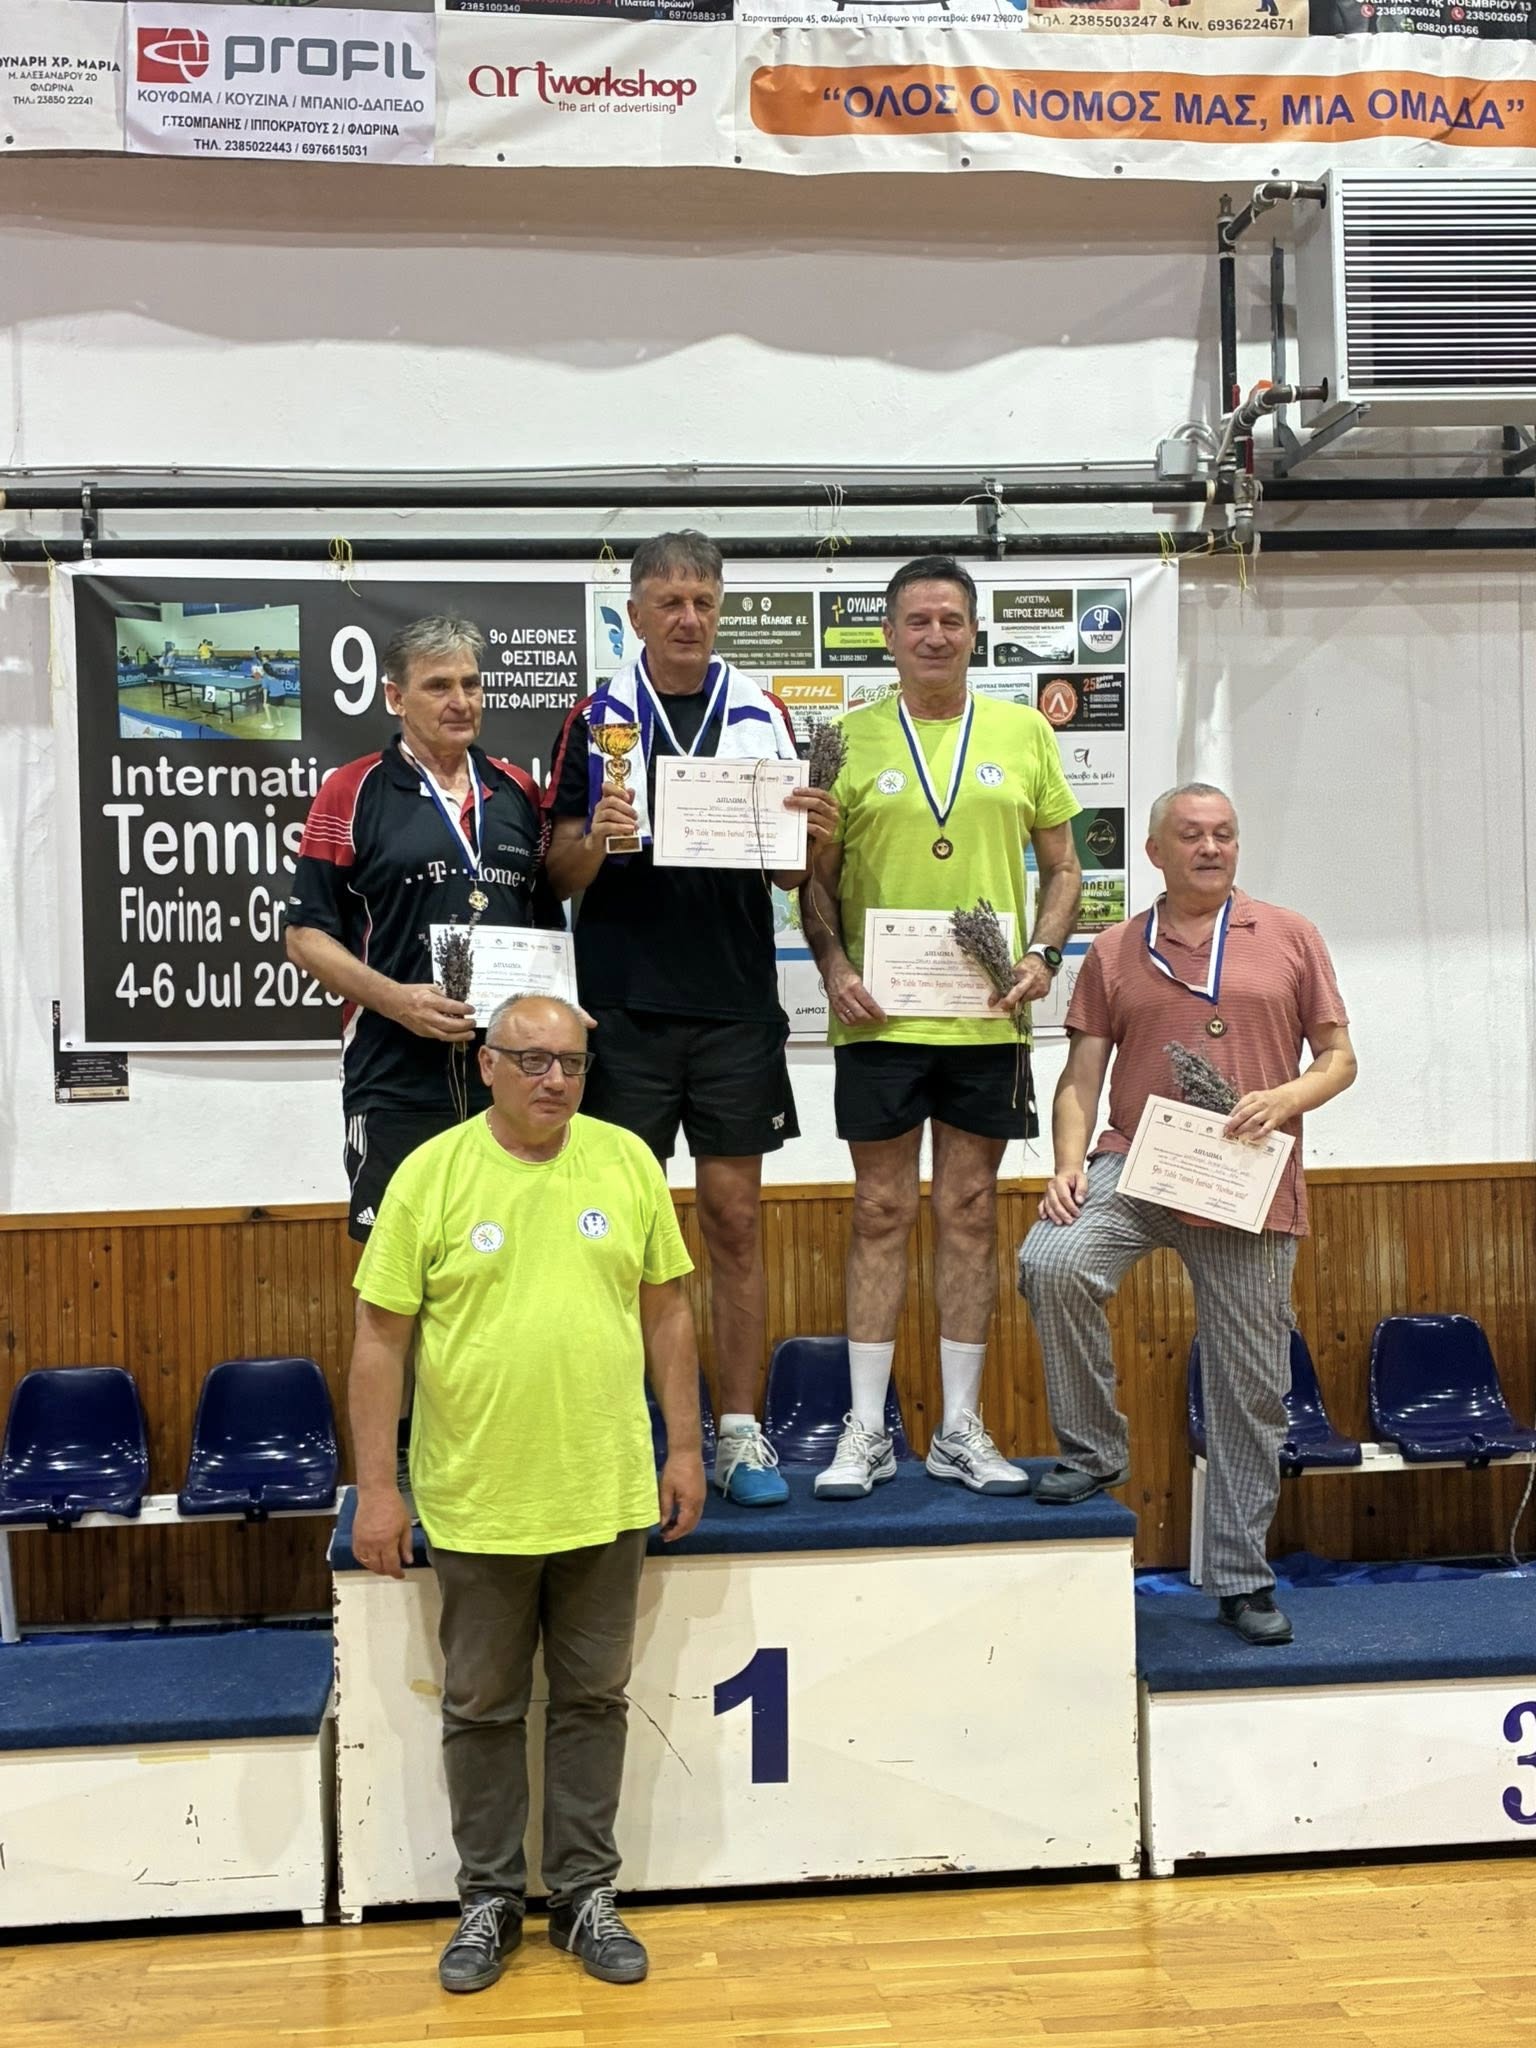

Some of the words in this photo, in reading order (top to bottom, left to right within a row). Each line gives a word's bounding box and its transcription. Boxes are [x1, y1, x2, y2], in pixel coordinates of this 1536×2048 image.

[742, 14, 803, 24] Σαρανταπόρου
[821, 14, 858, 24] Φλώρινα
[867, 14, 909, 24] Τηλέφωνο
[912, 15, 925, 24] για
[971, 14, 991, 23] 6947
[1376, 6, 1441, 18] 2385026024
[1466, 11, 1529, 23] 2385026057
[1033, 14, 1064, 27] Τηλ.
[1069, 15, 1157, 28] 2385503247
[1162, 17, 1173, 27] &
[1178, 17, 1202, 31] Κιν.
[1207, 19, 1294, 31] 6936224671
[1416, 21, 1479, 35] 6982016366
[51, 57, 73, 68] ΧΡ.
[77, 59, 121, 72] ΜΑΡΙΑ
[20, 71, 83, 80] ΑΛΕΞΑΝΔΡΟΥ
[85, 73, 98, 82] 20
[30, 83, 74, 92] ΦΛΩΡΙΝΑ
[37, 96, 66, 105] 23850
[67, 97, 93, 105] 22241
[137, 90, 212, 106] ΚΟΥΦΩΜΑ
[225, 93, 288, 108] ΚΟΥΖΙΝΑ
[301, 97, 425, 113] ΜΠΑΝΙΟ-ΔΑΠΕΔΟ
[559, 102, 577, 112] the
[580, 102, 597, 112] art
[599, 102, 611, 113] of
[613, 102, 676, 114] advertising
[824, 83, 958, 118] “ΟΛΟΣ
[970, 84, 1000, 116] Ο
[1012, 89, 1162, 122] ΝΟΜΟΣ
[1174, 92, 1268, 131] ΜΑΣ,
[1282, 93, 1355, 126] ΜΙΑ
[1368, 88, 1526, 130] ΟΜΑΔΑ”
[162, 116, 241, 130] Γ.ΤΣΟΜΠΑΝΗΣ
[250, 118, 329, 134] ΙΠΠΟΚΡΑΤΟΥΣ
[332, 122, 338, 133] 2
[347, 122, 400, 136] ΦΛΩΡΙΝΑ
[194, 138, 220, 151] ΤΗΛ.
[224, 140, 292, 154] 2385022443
[302, 142, 368, 157] 6976615031
[1003, 608, 1032, 618] ΠΕΤΡΟΣ
[1033, 607, 1065, 618] ΣΕΡΙΔΗΣ
[511, 629, 577, 644] ΔΙΕΘΝΕΣ
[501, 650, 578, 667] ΦΕΣΤΙΒΑΛ
[780, 685, 837, 697] STIHL
[1083, 677, 1095, 692] 25
[207, 691, 214, 701] 2
[120, 886, 222, 943] Florina
[115, 962, 176, 1008] 4-6
[186, 961, 241, 1008] Jul
[795, 1006, 827, 1015] ΔΗΜΟΣ
[713, 1647, 789, 1784] 1
